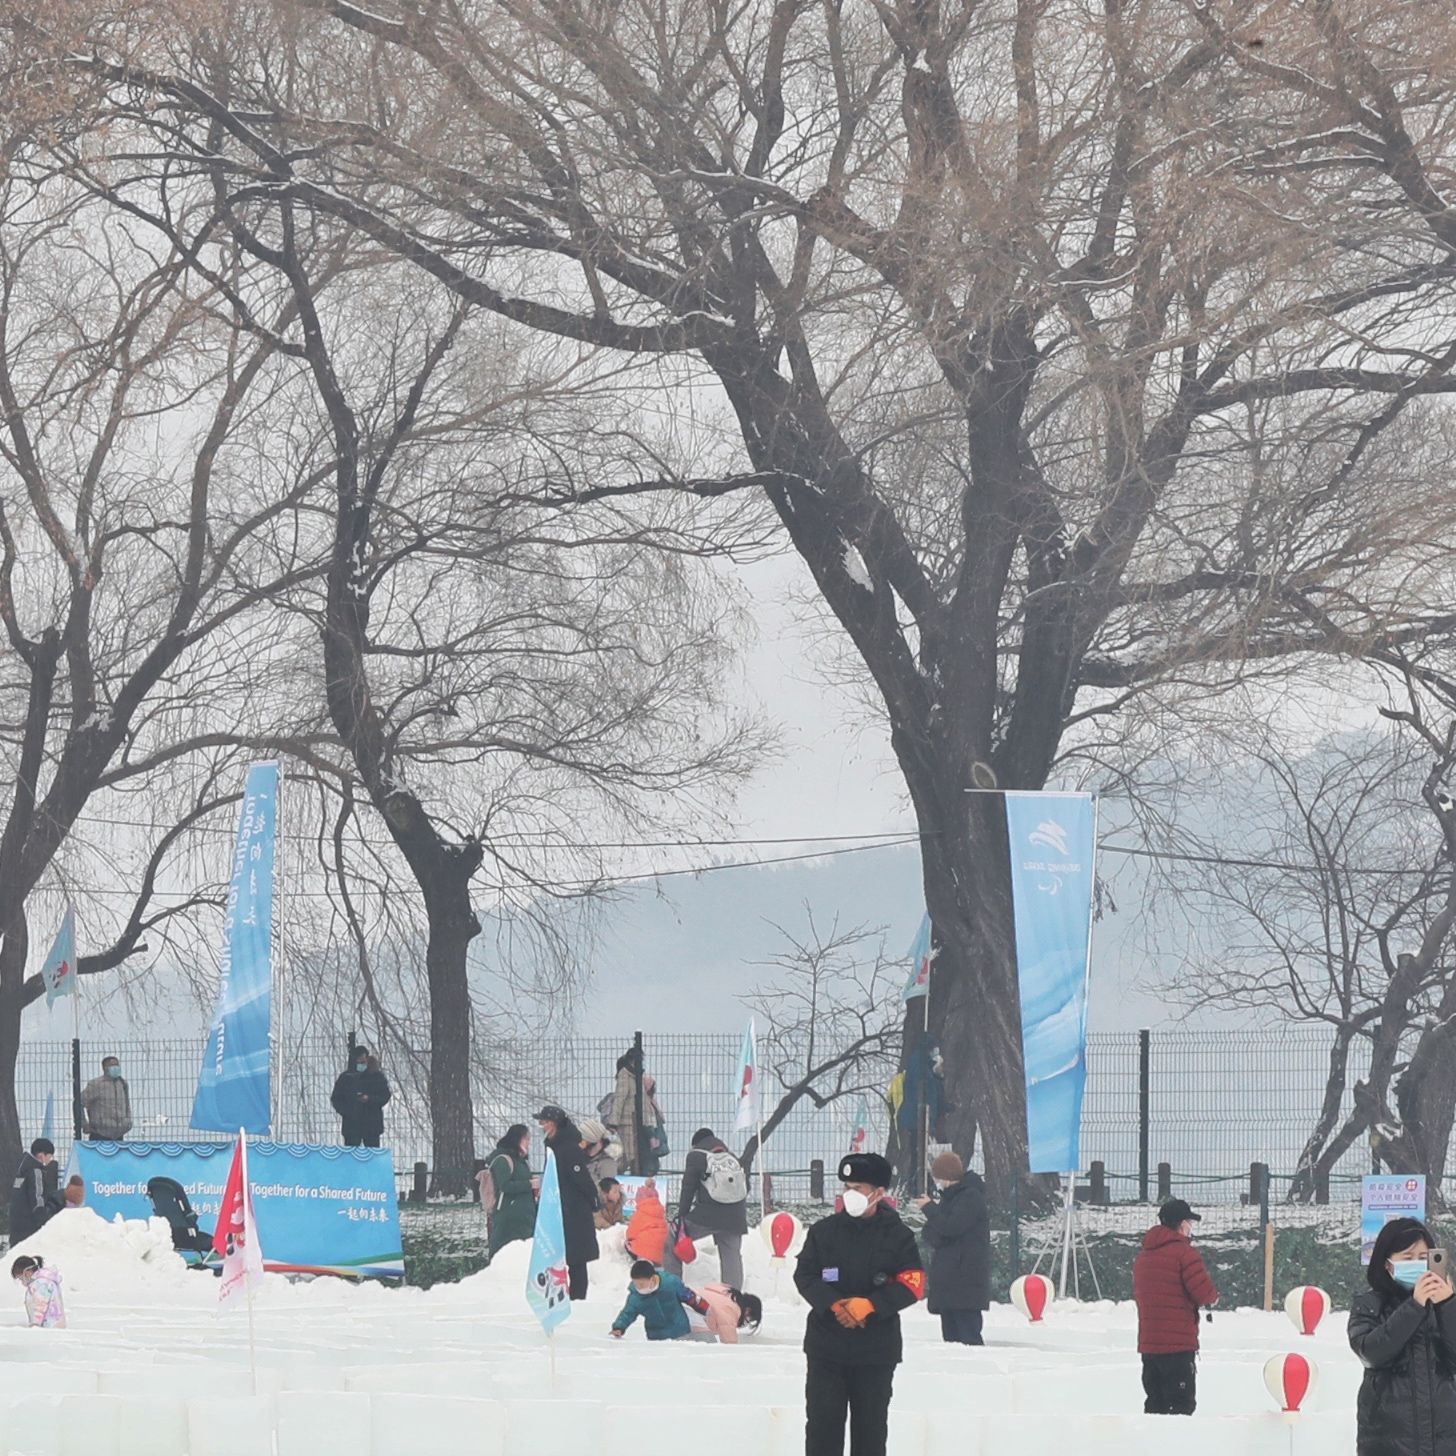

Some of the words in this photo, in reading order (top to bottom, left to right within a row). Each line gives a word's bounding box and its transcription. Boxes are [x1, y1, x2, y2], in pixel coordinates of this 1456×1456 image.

[92, 1181, 136, 1196] Together
[137, 1182, 151, 1195] fo
[249, 1182, 293, 1198] Together
[295, 1184, 310, 1198] for
[310, 1188, 318, 1198] a
[319, 1186, 353, 1200] Shared
[355, 1188, 387, 1201] Future
[337, 1207, 389, 1222] 一起向未来
